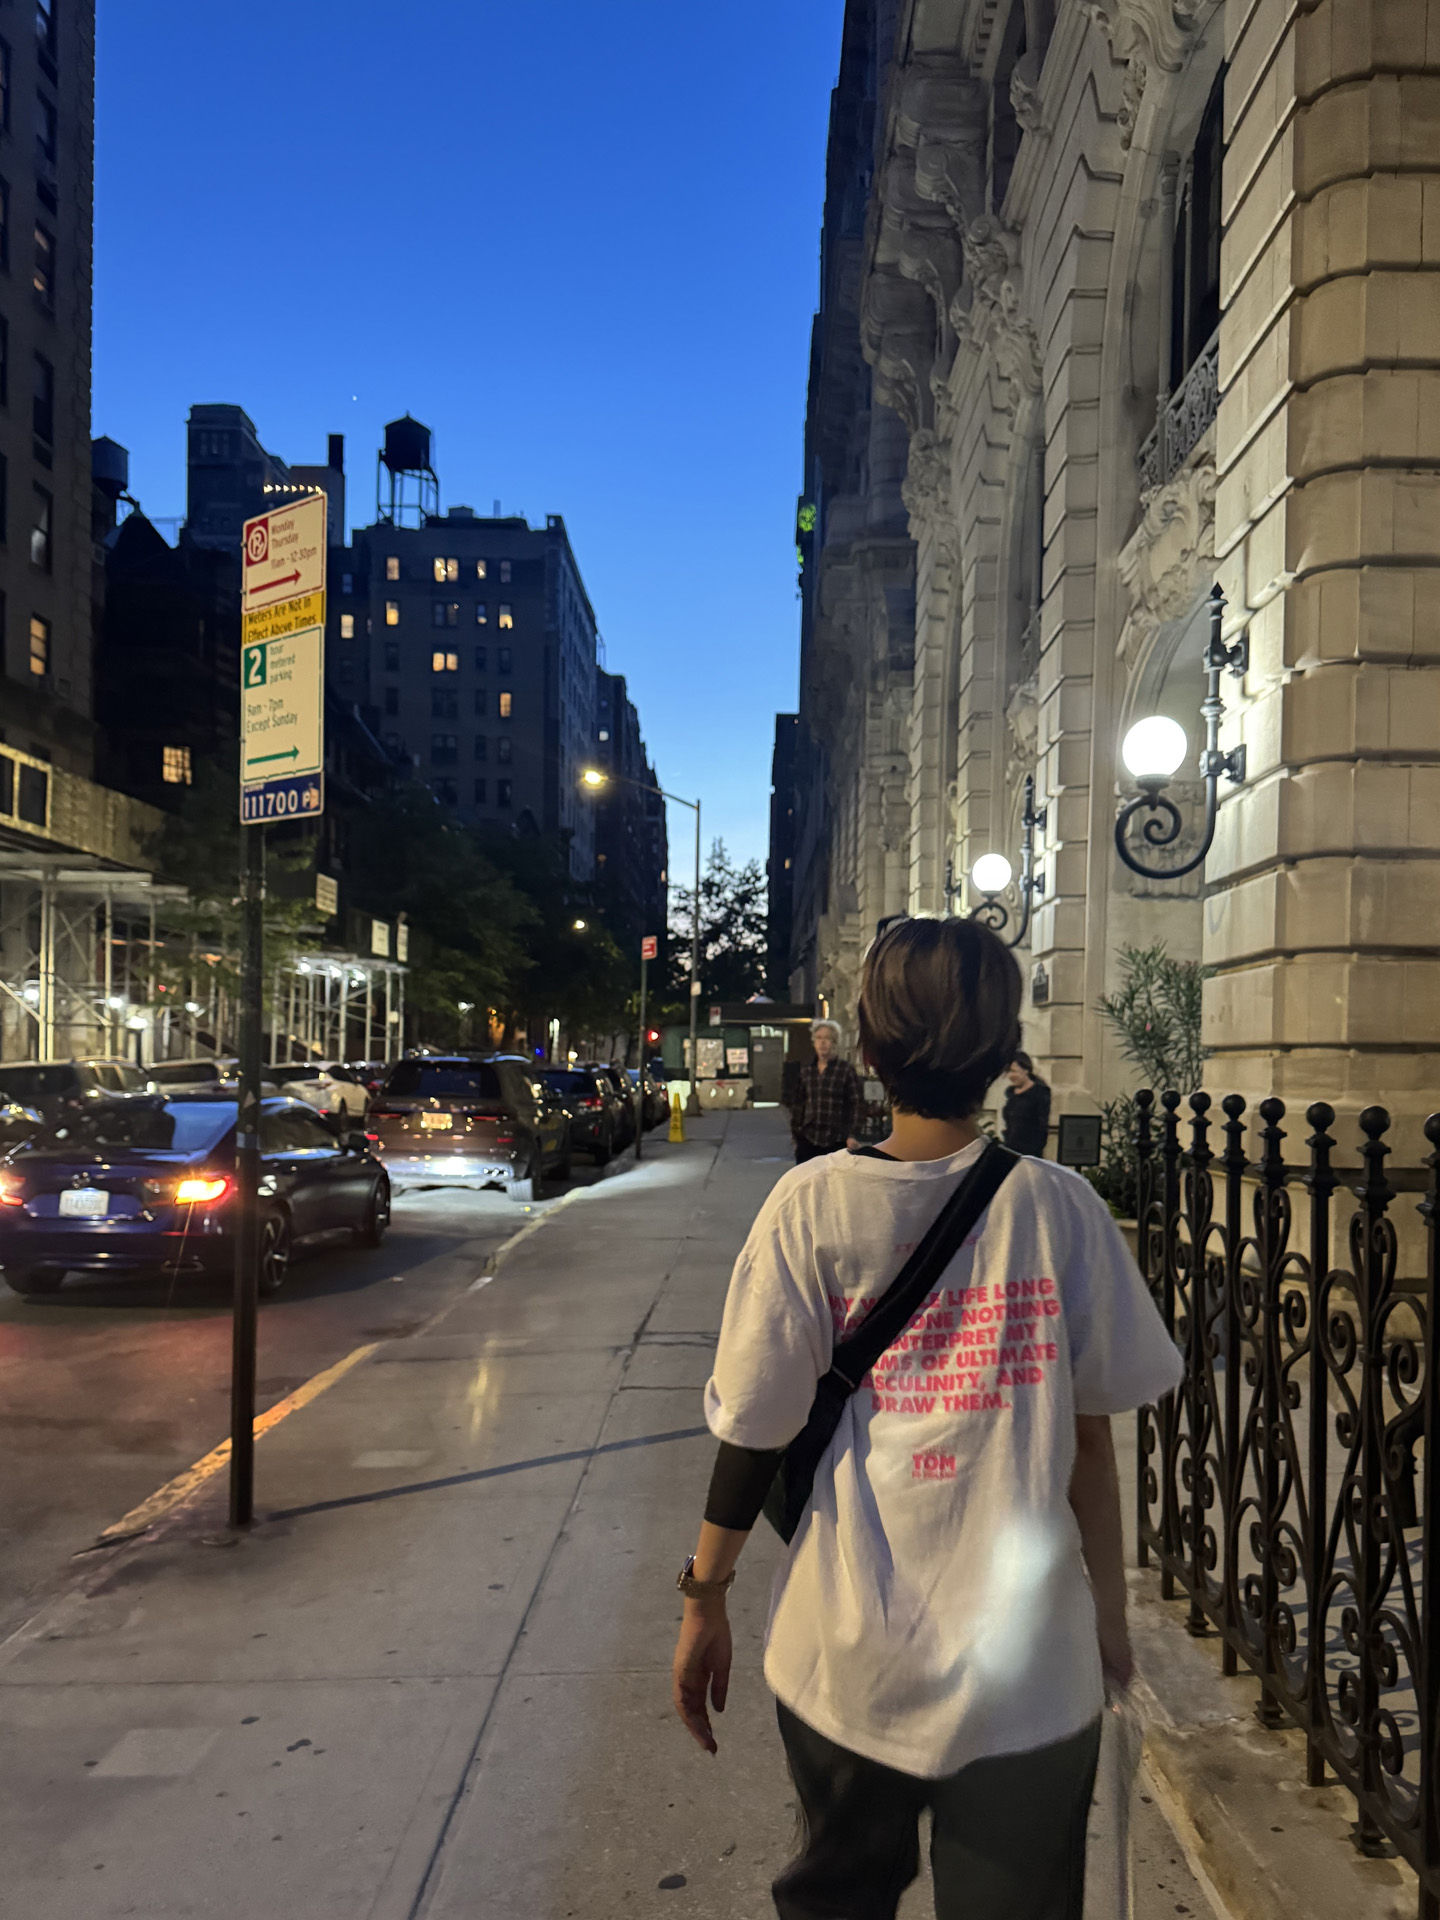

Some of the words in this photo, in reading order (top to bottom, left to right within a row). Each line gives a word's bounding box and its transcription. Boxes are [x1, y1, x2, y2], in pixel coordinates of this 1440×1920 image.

[271, 519, 295, 535] Monday
[271, 533, 299, 549] Thursday
[274, 604, 286, 617] Are
[288, 599, 302, 612] Not
[248, 627, 269, 644] Effect
[271, 621, 292, 636] Above
[294, 613, 317, 630] Times
[249, 648, 262, 685] 2
[270, 653, 296, 670] metered
[270, 670, 292, 686] parking
[247, 717, 271, 734] Except
[272, 712, 298, 729] Sunday
[244, 789, 298, 818] 111700
[947, 1286, 988, 1307] LIFE
[994, 1278, 1055, 1300] LONG
[907, 1311, 955, 1331] ONE
[961, 1299, 1061, 1326] NOTHING
[1006, 1322, 1038, 1341] MY
[921, 1352, 949, 1371] OF
[956, 1342, 1059, 1369] ULTIMATE
[996, 1366, 1044, 1386] AND
[871, 1395, 937, 1414] DRAW
[942, 1391, 1012, 1412] THEM.
[912, 1454, 957, 1471] TOM
